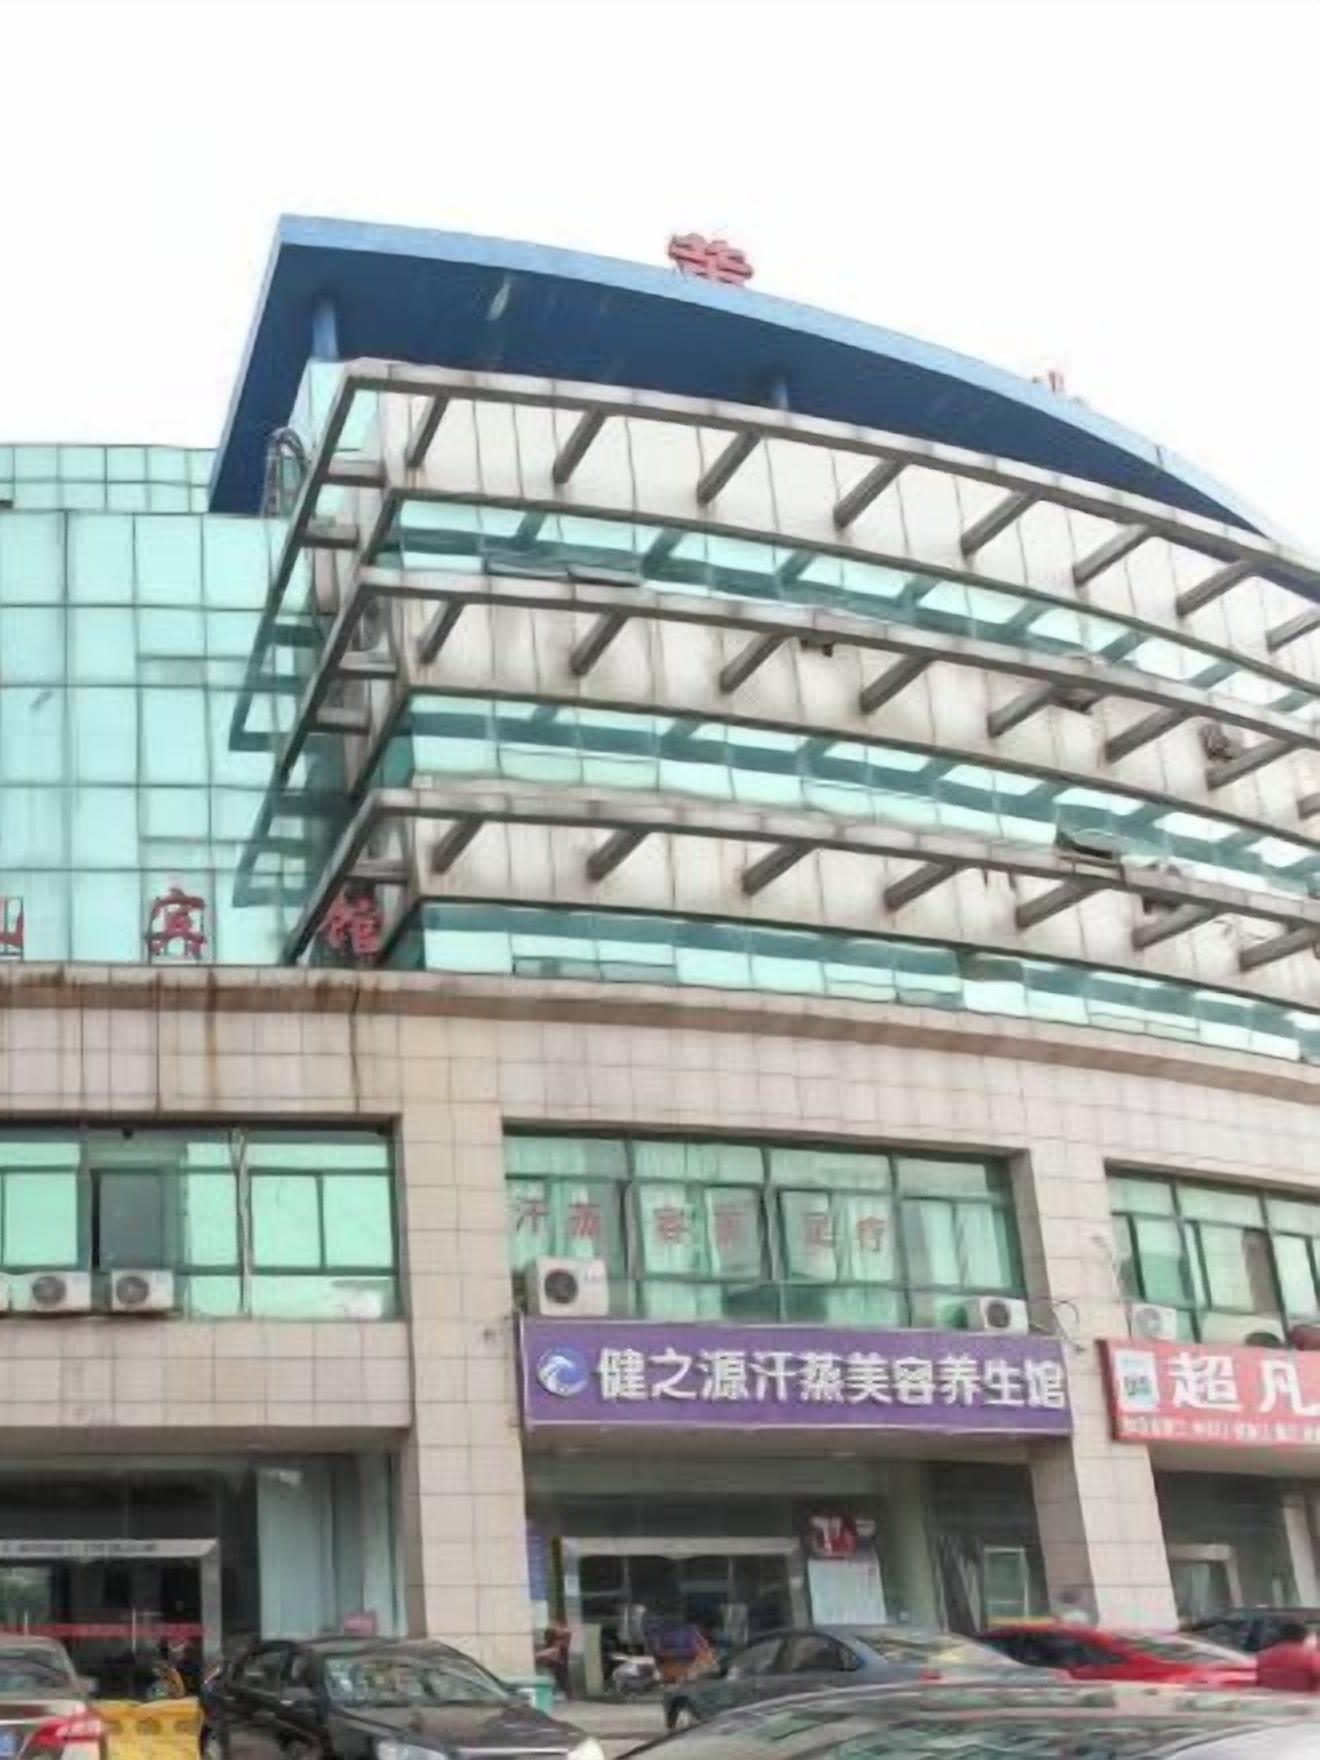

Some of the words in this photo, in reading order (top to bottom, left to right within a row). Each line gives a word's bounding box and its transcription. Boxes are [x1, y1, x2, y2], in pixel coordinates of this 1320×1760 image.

[599, 1346, 1066, 1411] 健之源汗蒸美容养生馆
[1167, 1351, 1320, 1417] 超凡
